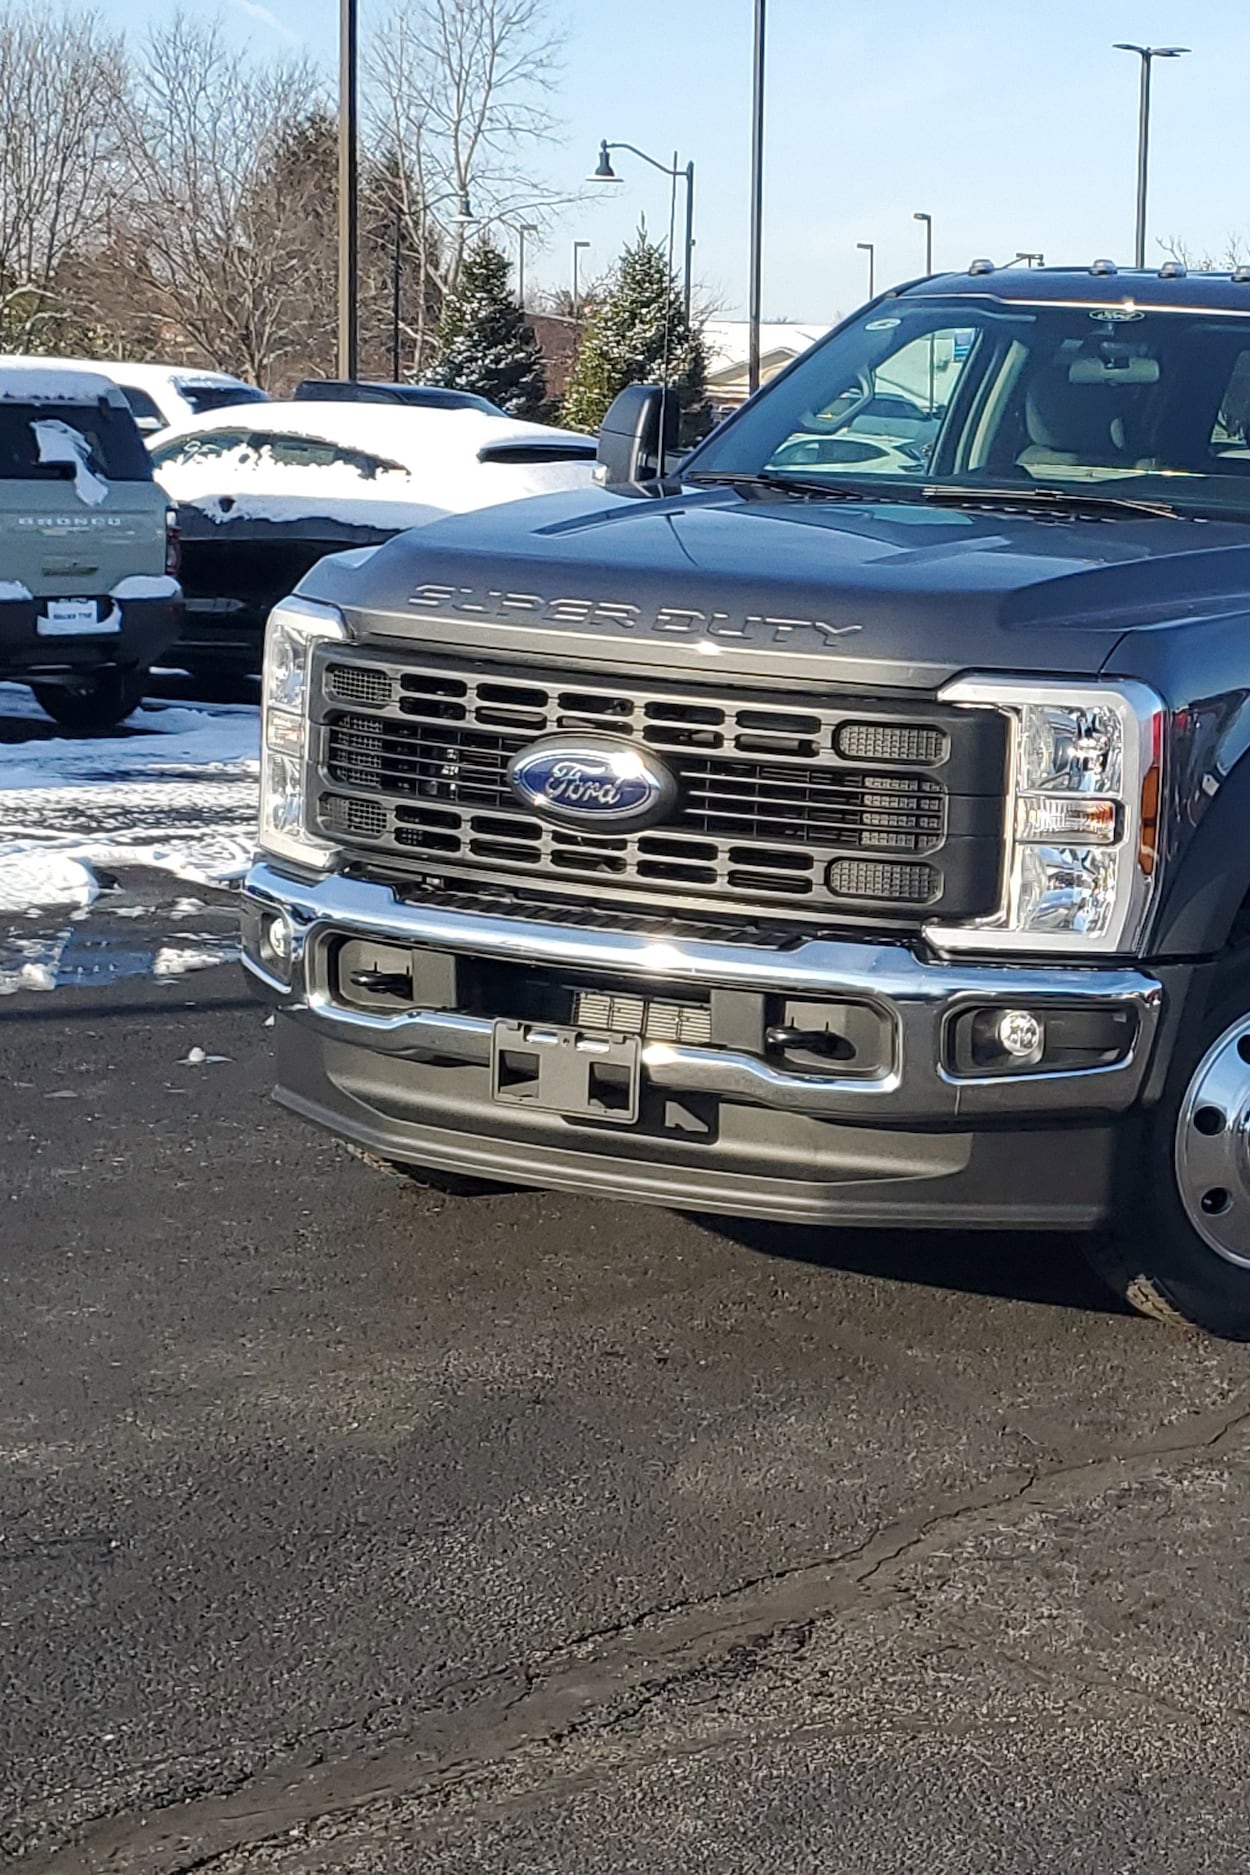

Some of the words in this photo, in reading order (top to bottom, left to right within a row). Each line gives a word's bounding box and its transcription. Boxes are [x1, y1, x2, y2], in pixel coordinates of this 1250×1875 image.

[18, 517, 121, 526] BRONCO
[408, 584, 641, 629] SUPER
[651, 608, 863, 647] DUTY
[544, 761, 624, 805] Ford
